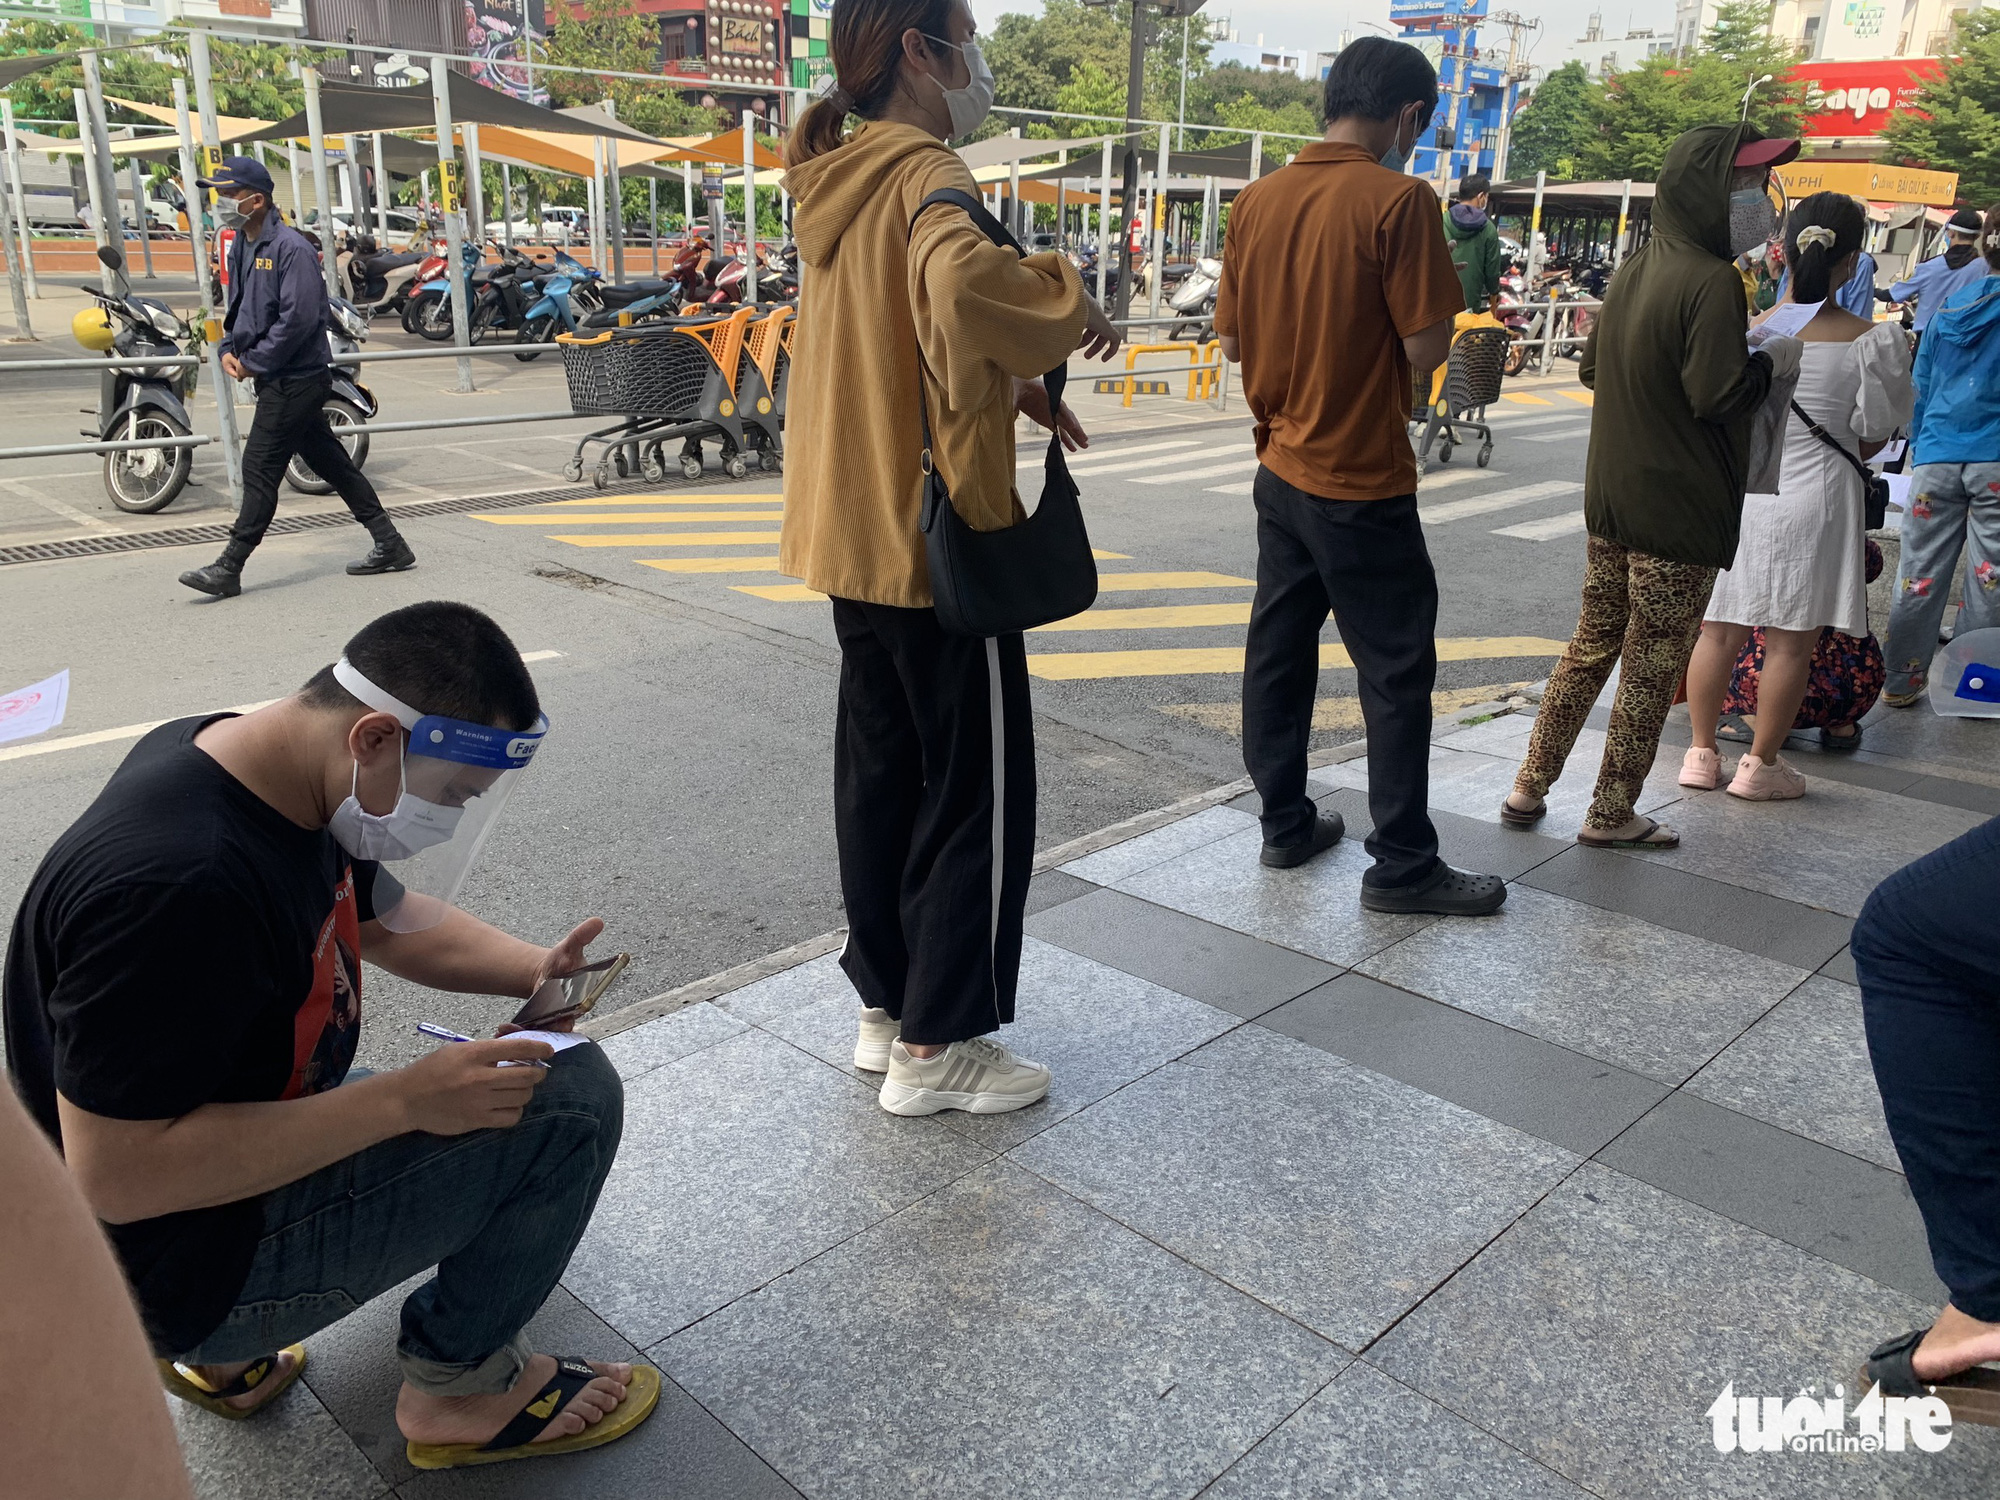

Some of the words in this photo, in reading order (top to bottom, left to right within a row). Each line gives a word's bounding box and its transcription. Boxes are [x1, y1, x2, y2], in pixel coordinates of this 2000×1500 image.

[1391, 2, 1424, 11] Domino's
[1425, 1, 1444, 9] Pizza
[724, 20, 760, 42] Bách
[446, 162, 458, 212] B08
[1798, 174, 1824, 188] PHÍ
[455, 728, 493, 742] Warning!
[514, 742, 538, 755] Fac
